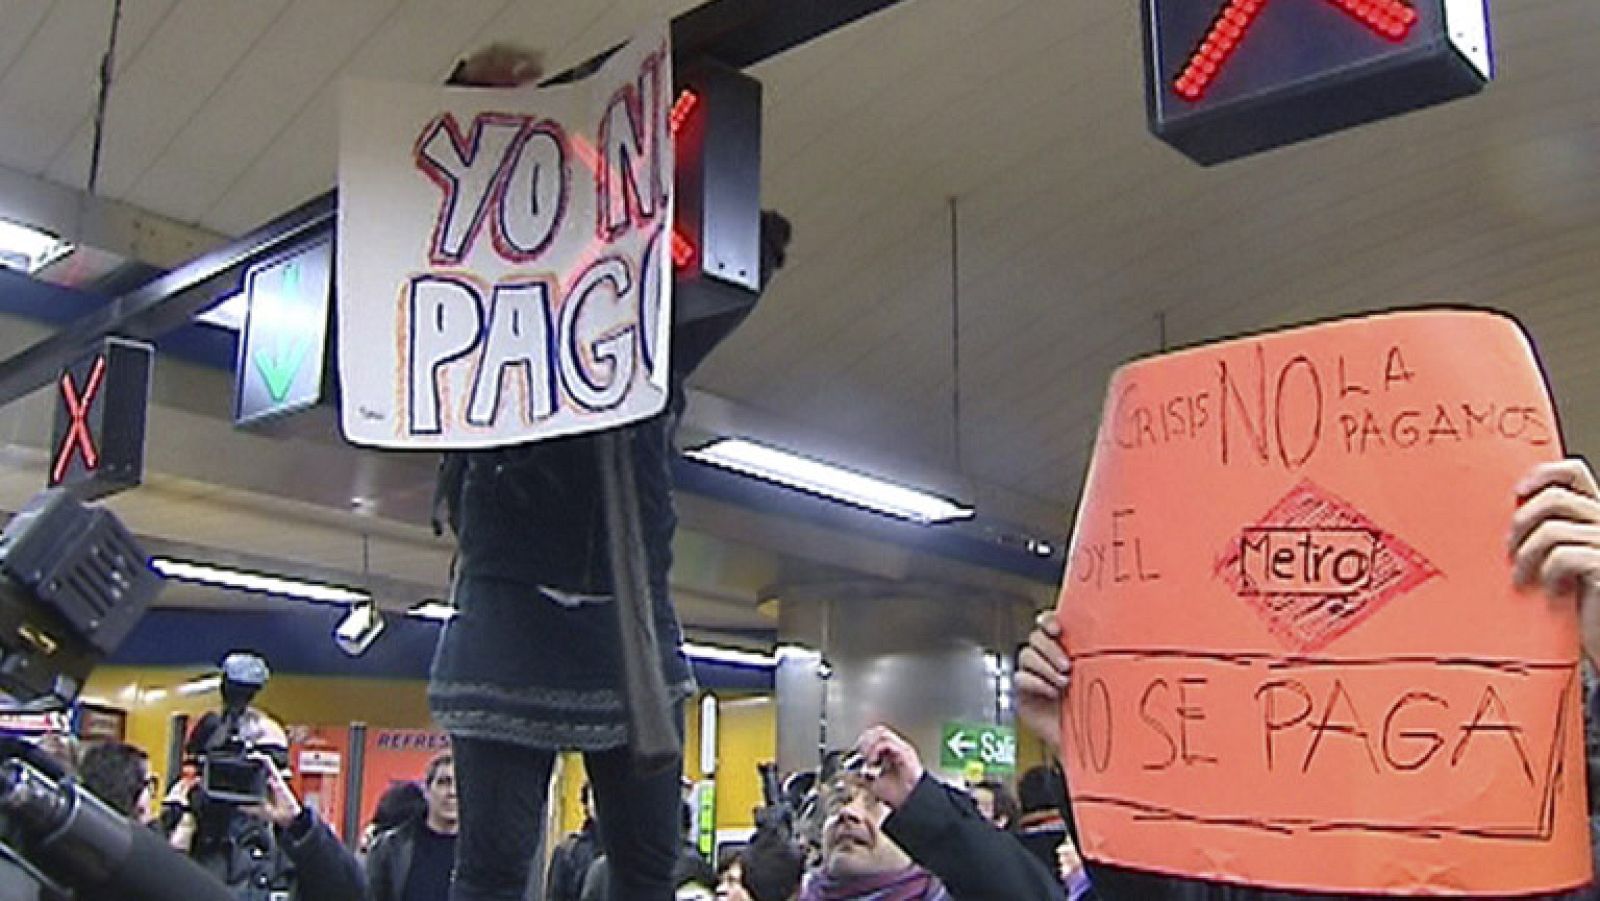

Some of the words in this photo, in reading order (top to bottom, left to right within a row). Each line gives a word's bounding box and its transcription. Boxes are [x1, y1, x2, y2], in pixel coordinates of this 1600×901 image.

[414, 112, 570, 266] YO
[599, 40, 669, 243] N
[1114, 382, 1209, 449] CRISIS
[1217, 343, 1323, 469] NO
[1338, 345, 1416, 398] LA
[1338, 402, 1551, 455] PAGAMOS
[1239, 532, 1370, 586] Metro
[1139, 677, 1219, 771] SE
[1254, 679, 1535, 786] PAGA
